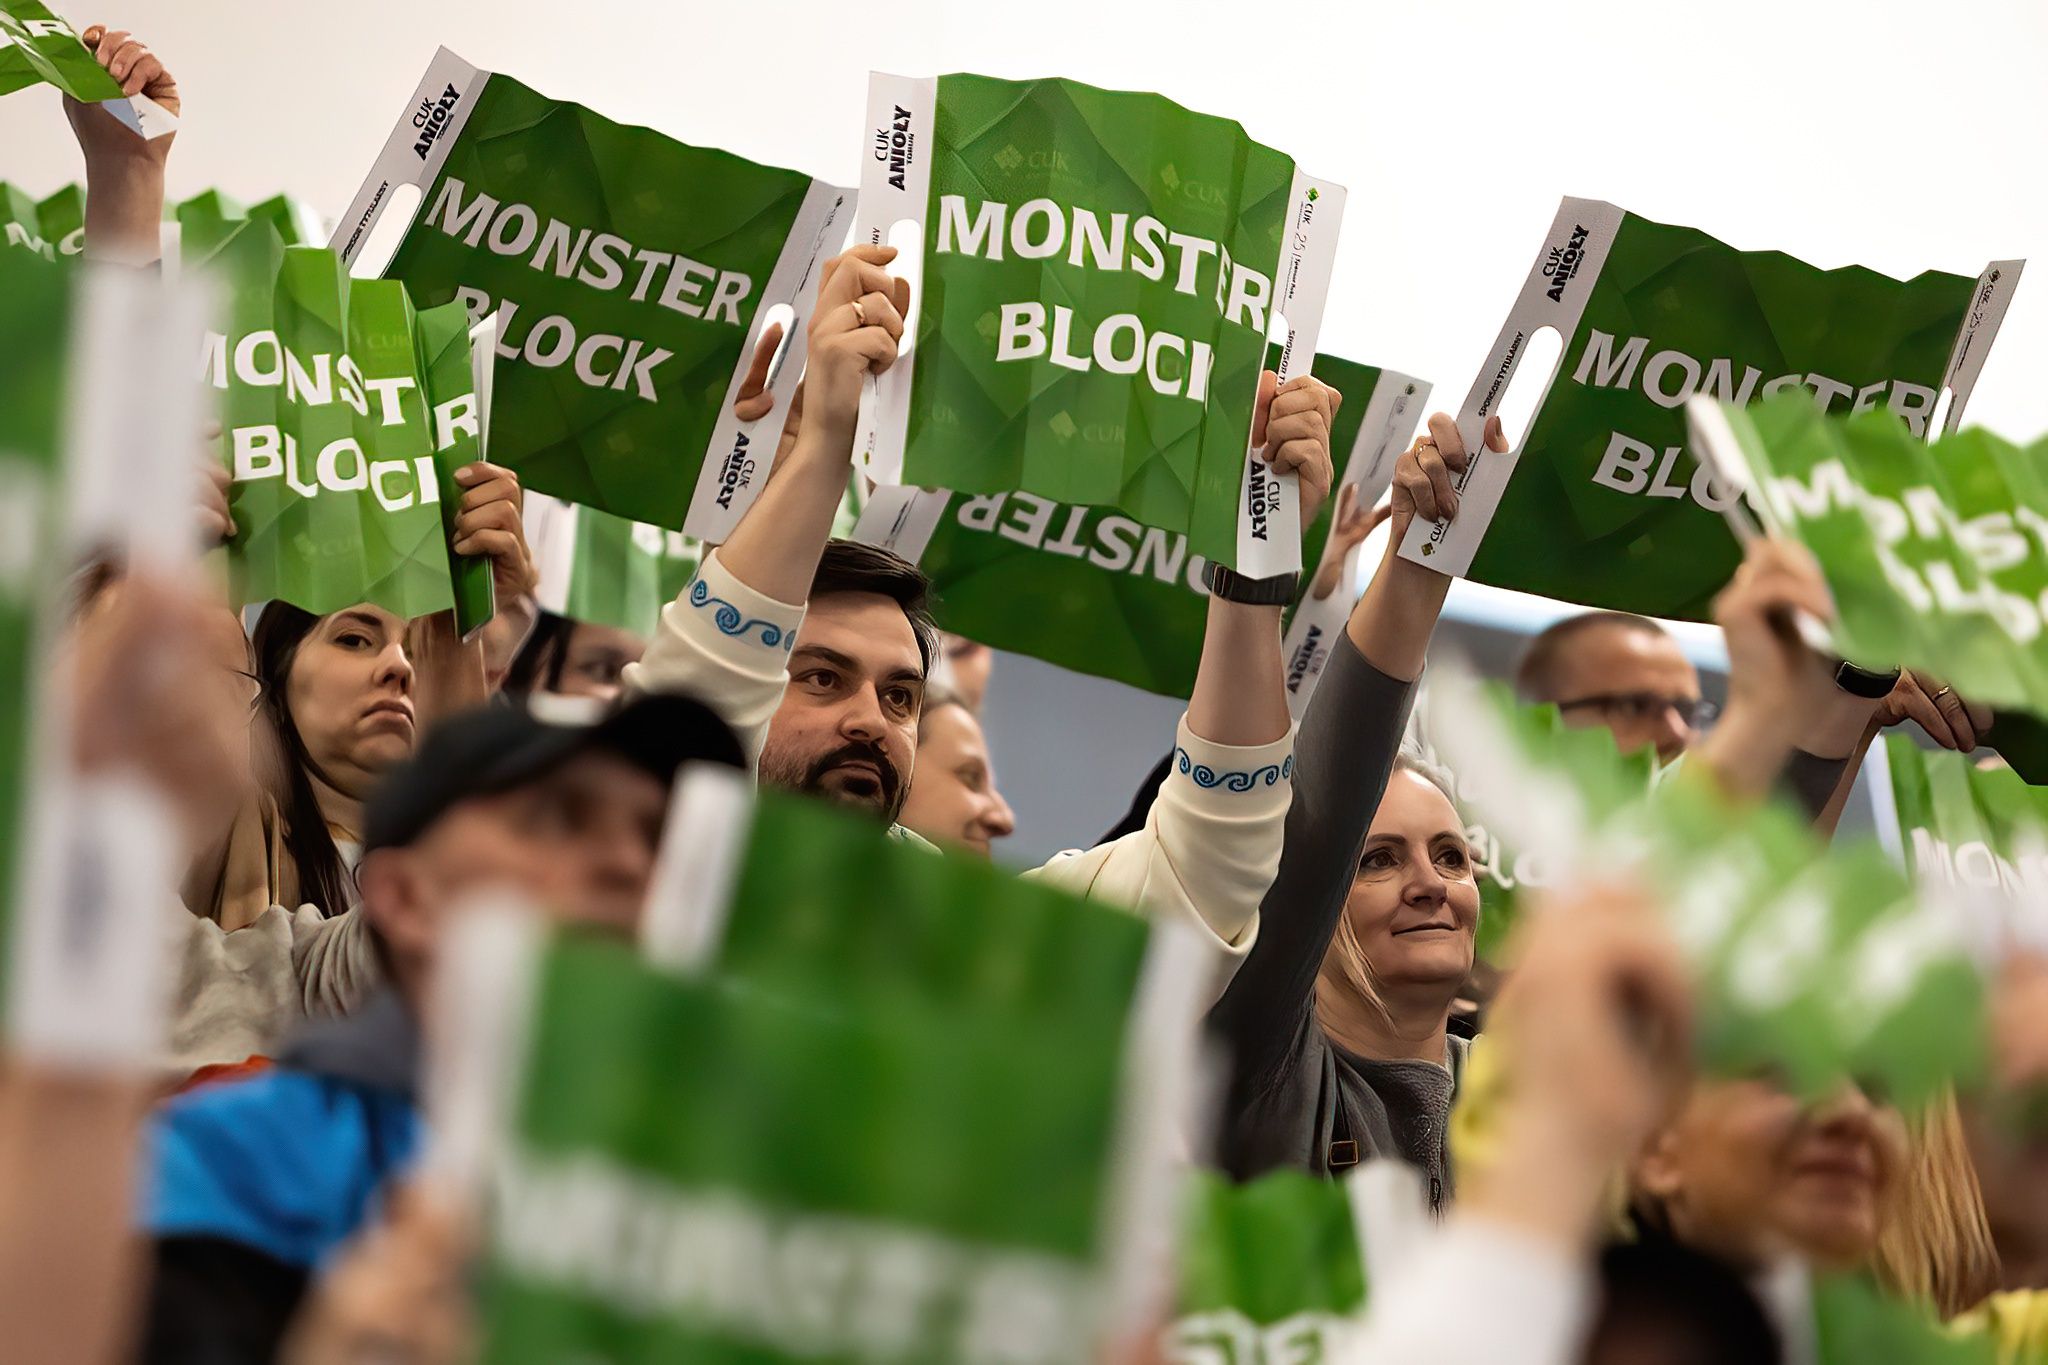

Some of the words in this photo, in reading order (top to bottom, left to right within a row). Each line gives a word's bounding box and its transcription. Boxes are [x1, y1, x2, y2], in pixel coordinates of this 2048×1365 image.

[413, 97, 435, 128] CUK
[413, 82, 461, 161] ANIOŁY
[874, 128, 890, 161] CUK
[888, 104, 912, 191] ANIOŁY
[424, 176, 752, 326] MONSTER
[1301, 203, 1314, 225] CUK
[935, 194, 1272, 337] MONSTER
[1542, 246, 1564, 277] CUK
[1546, 224, 1590, 303] ANIOŁY
[200, 328, 479, 451] ONSTR
[737, 460, 755, 489] CUK
[1250, 459, 1268, 541] ANIOŁY
[1267, 481, 1281, 514] CUK
[1591, 431, 1746, 513] BLO
[957, 490, 1212, 595] NSTER
